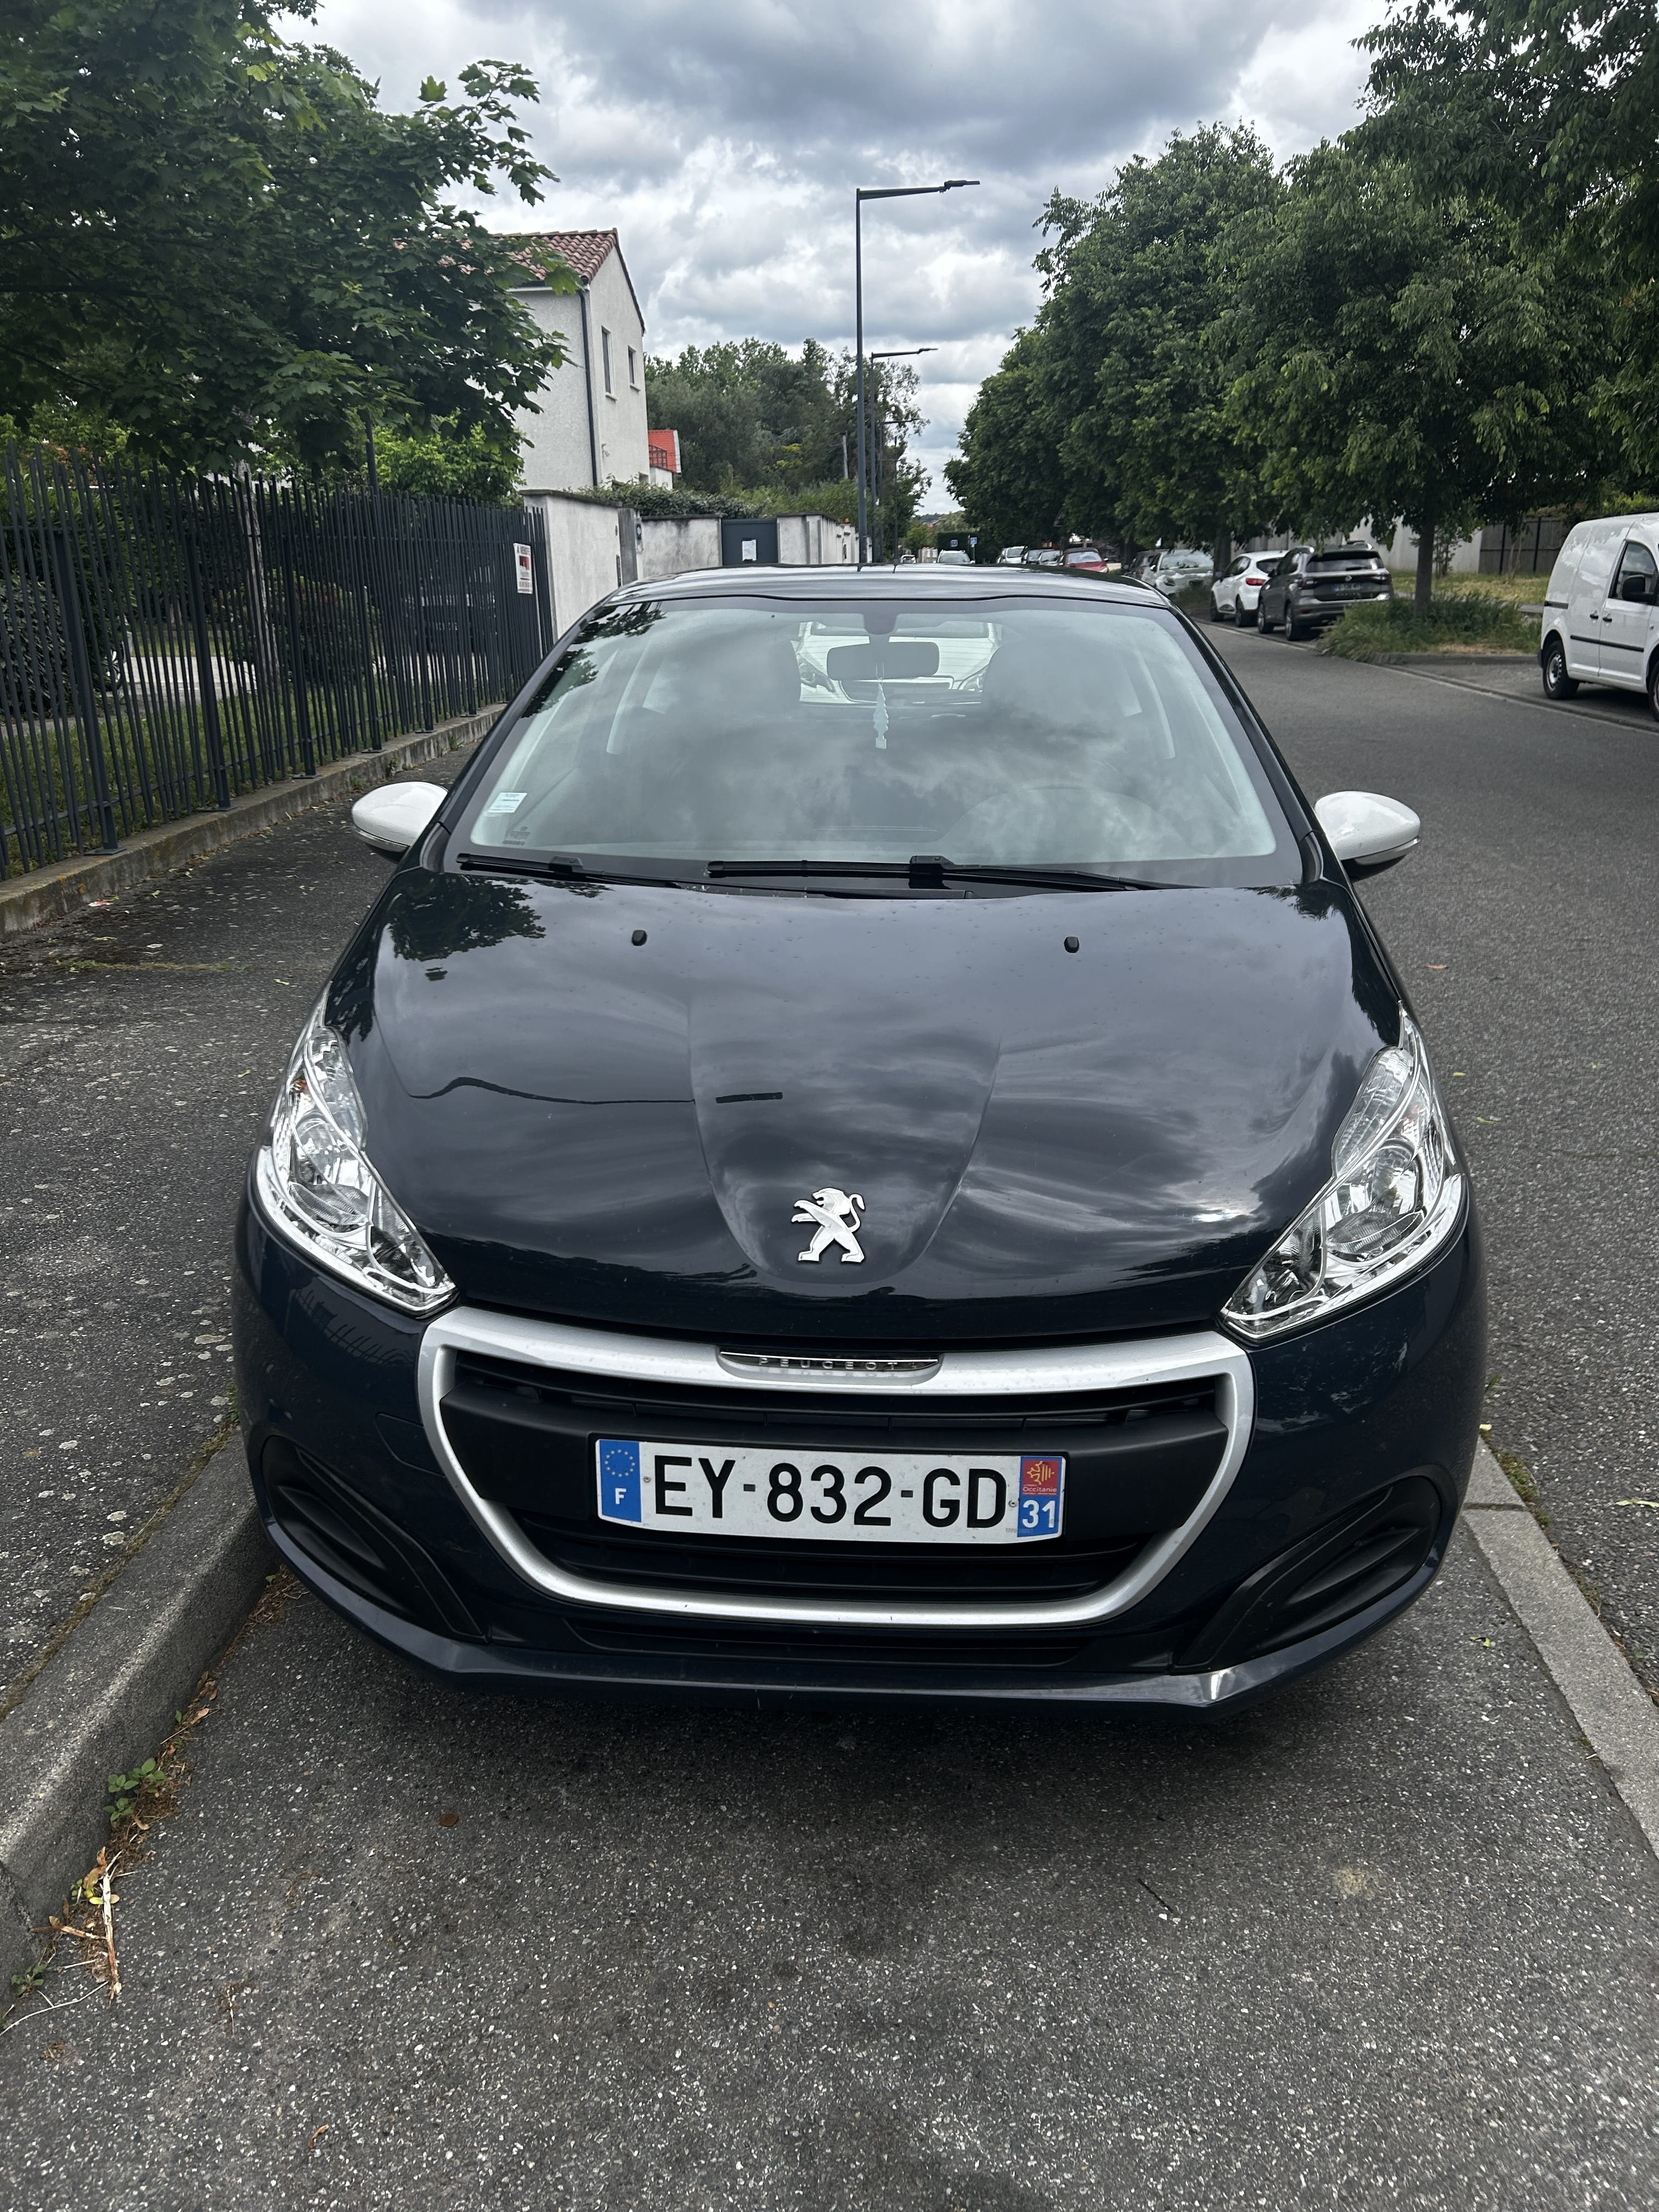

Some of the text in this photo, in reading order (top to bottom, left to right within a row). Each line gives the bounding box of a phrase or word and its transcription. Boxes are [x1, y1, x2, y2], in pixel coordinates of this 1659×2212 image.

[759, 1357, 898, 1370] PEUGEOT
[615, 1488, 627, 1504] F
[654, 1455, 1006, 1528] EY-832-GD
[1023, 1500, 1056, 1528] 31
